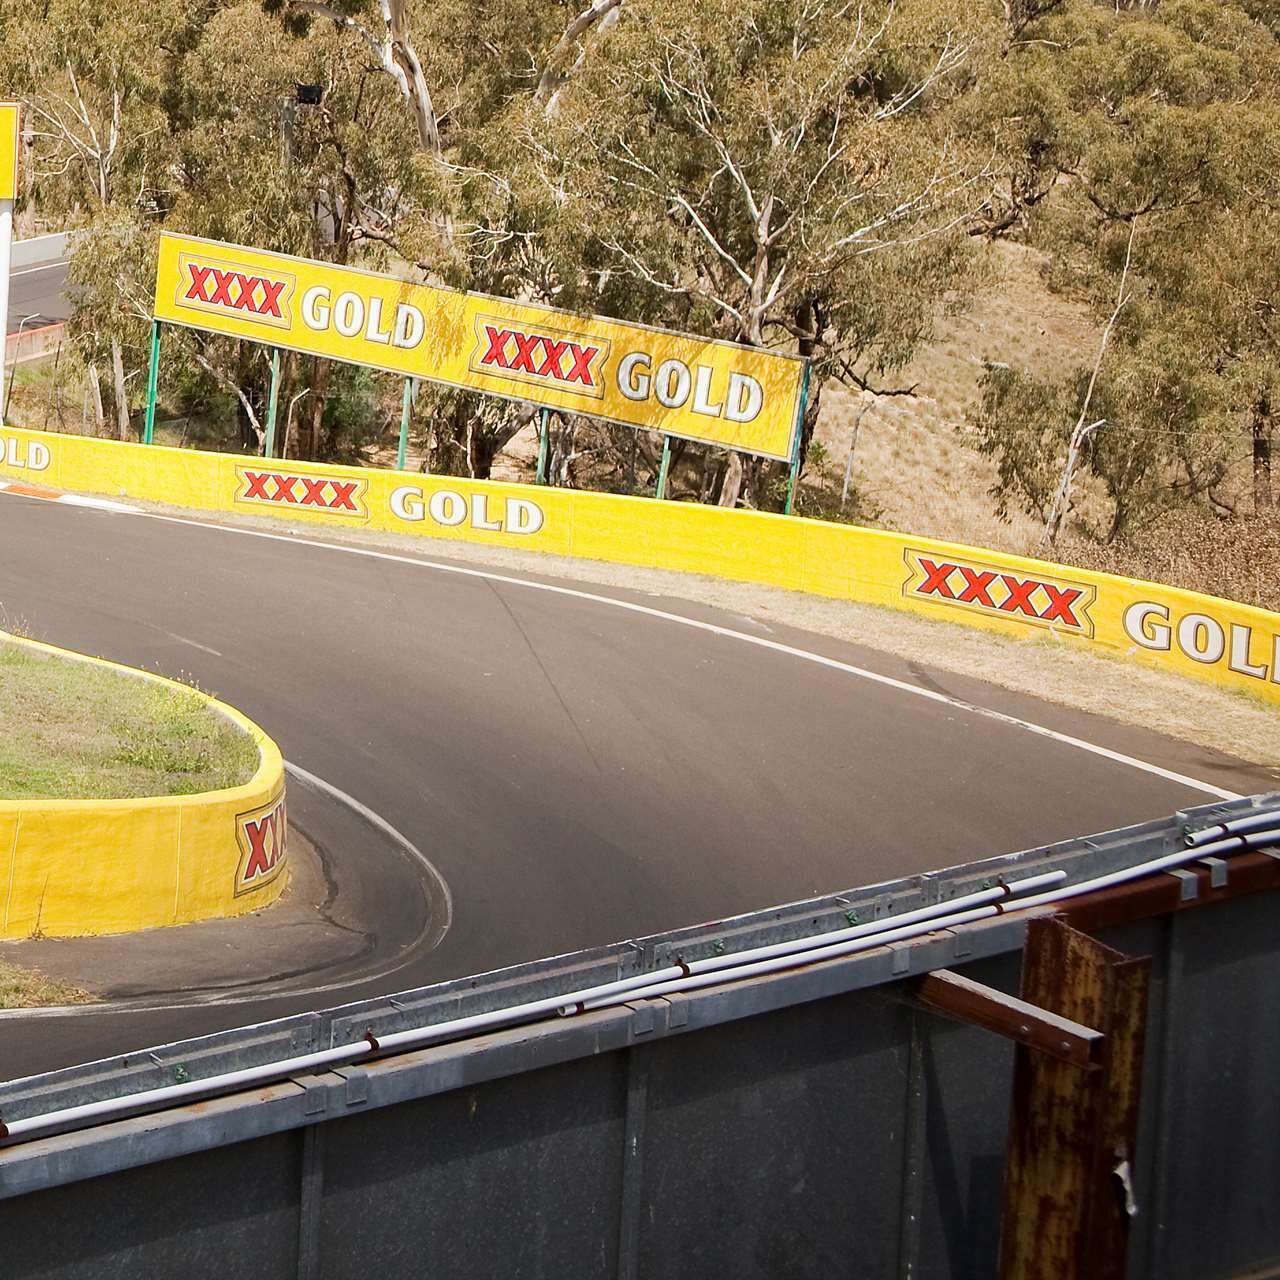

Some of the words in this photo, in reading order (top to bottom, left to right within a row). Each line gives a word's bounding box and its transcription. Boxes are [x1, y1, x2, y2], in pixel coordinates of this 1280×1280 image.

[185, 263, 286, 319] XXXX
[301, 286, 425, 349] GOLD
[479, 325, 600, 387] XXXX
[616, 352, 763, 423] GOLD
[243, 471, 361, 511] XXXX
[389, 485, 545, 535] GOLD
[917, 557, 1083, 628] XXXX
